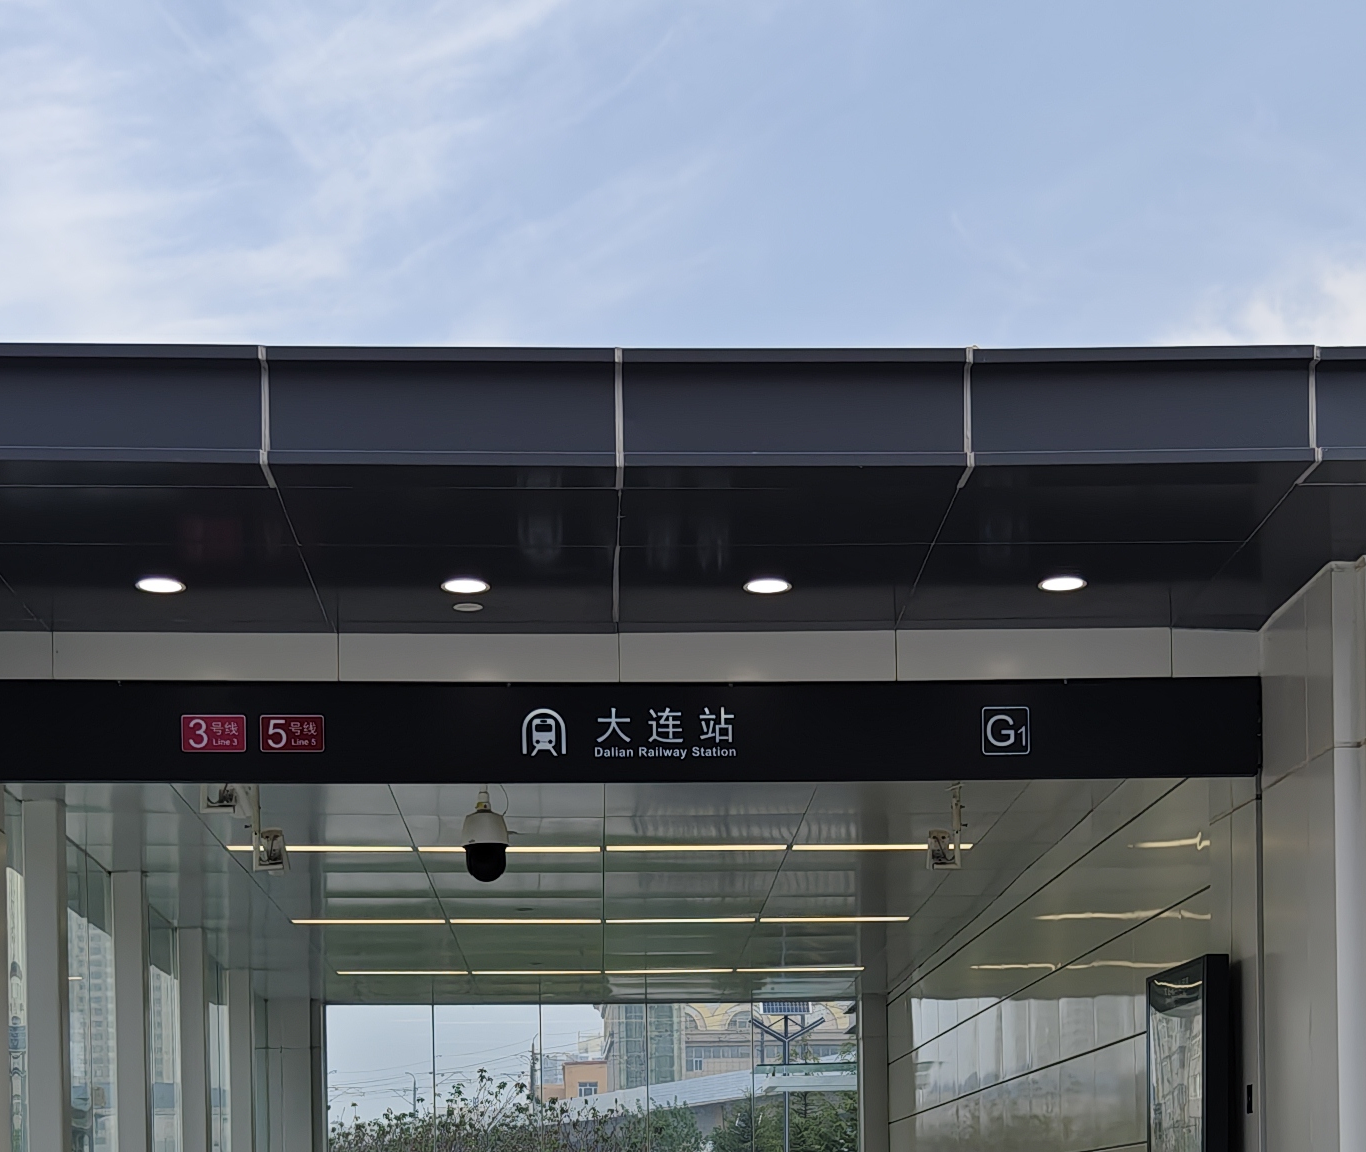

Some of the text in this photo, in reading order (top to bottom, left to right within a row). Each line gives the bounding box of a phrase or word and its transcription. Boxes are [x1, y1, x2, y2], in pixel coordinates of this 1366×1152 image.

[189, 719, 239, 748] 3号线
[268, 719, 318, 748] 5号线
[596, 707, 735, 744] 大连站
[985, 714, 1027, 747] G1
[213, 738, 238, 746] Line 3
[291, 738, 317, 746] Line 5
[594, 746, 737, 760] Dalian Railway Station
